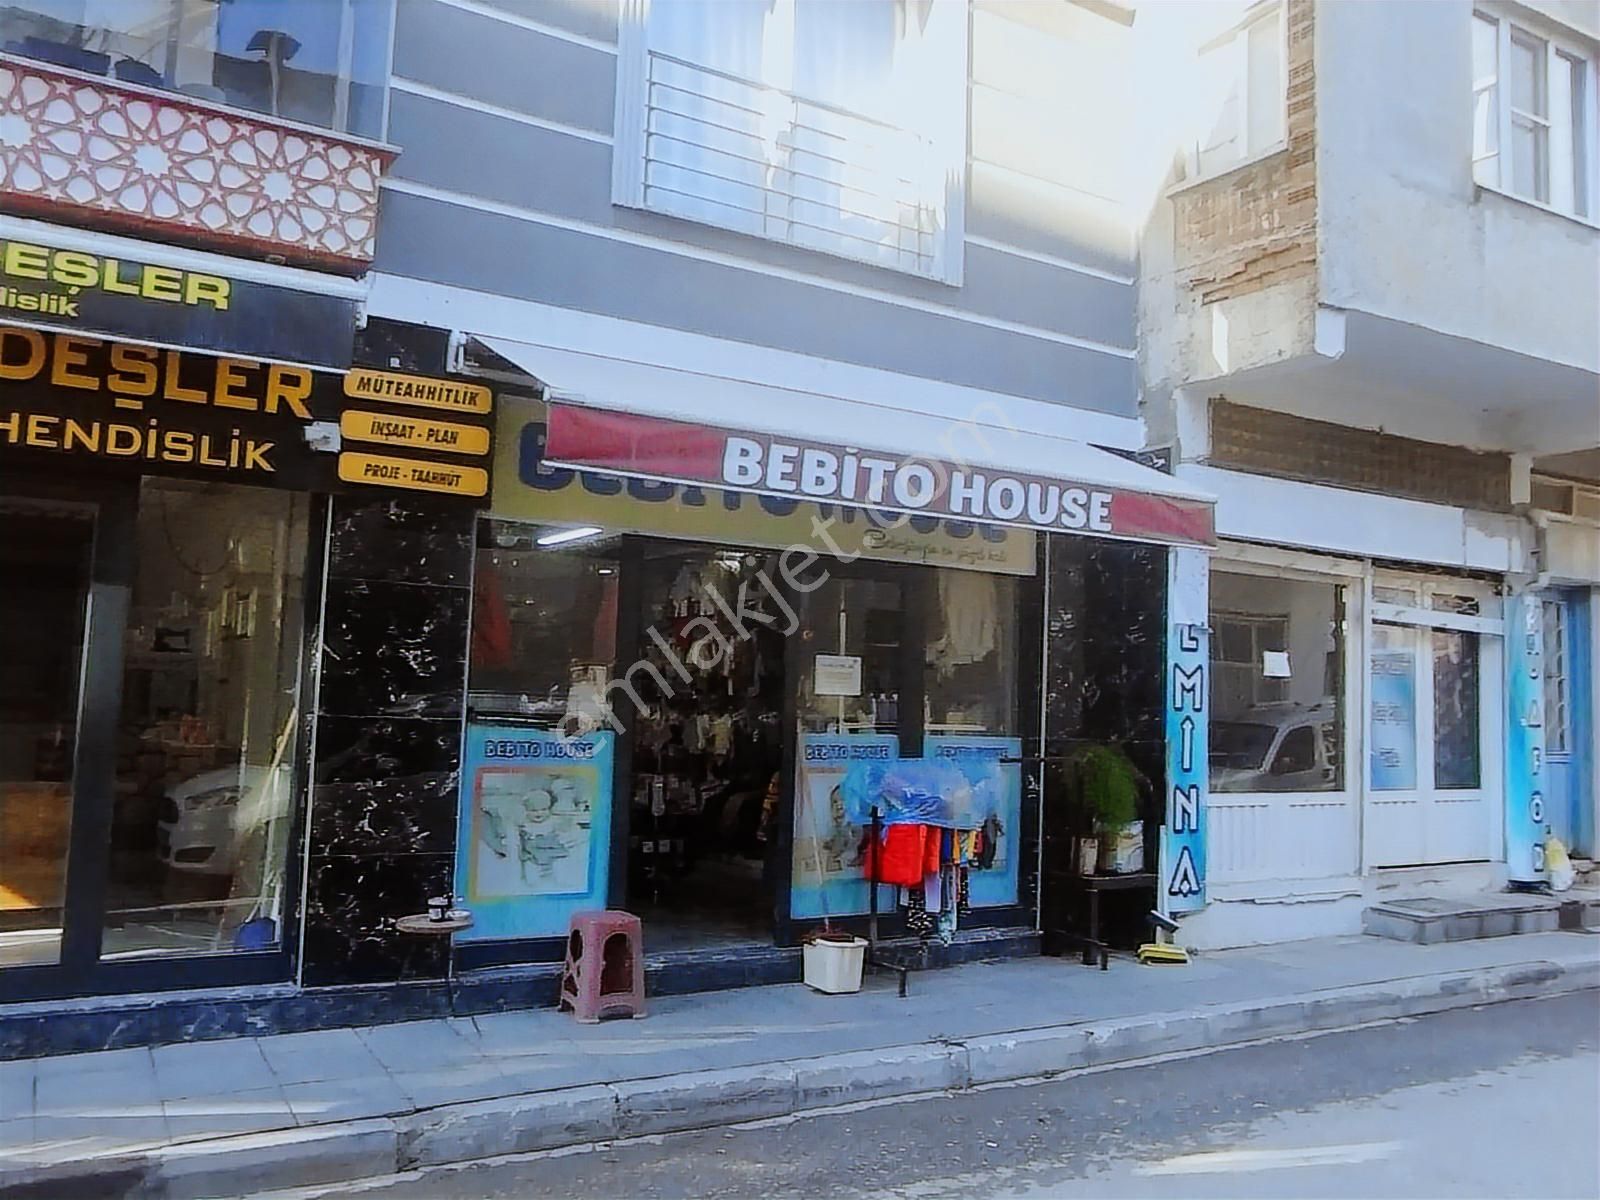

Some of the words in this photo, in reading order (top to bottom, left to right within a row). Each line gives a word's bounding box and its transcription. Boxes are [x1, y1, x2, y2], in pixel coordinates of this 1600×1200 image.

[356, 375, 480, 407] MÜTEAHHİTLİK
[370, 417, 416, 441] İNŞAAT
[426, 427, 460, 445] PLAN
[364, 463, 401, 480] PROJE
[721, 436, 936, 509] BEBİTO
[947, 470, 1114, 532] HOUSE
